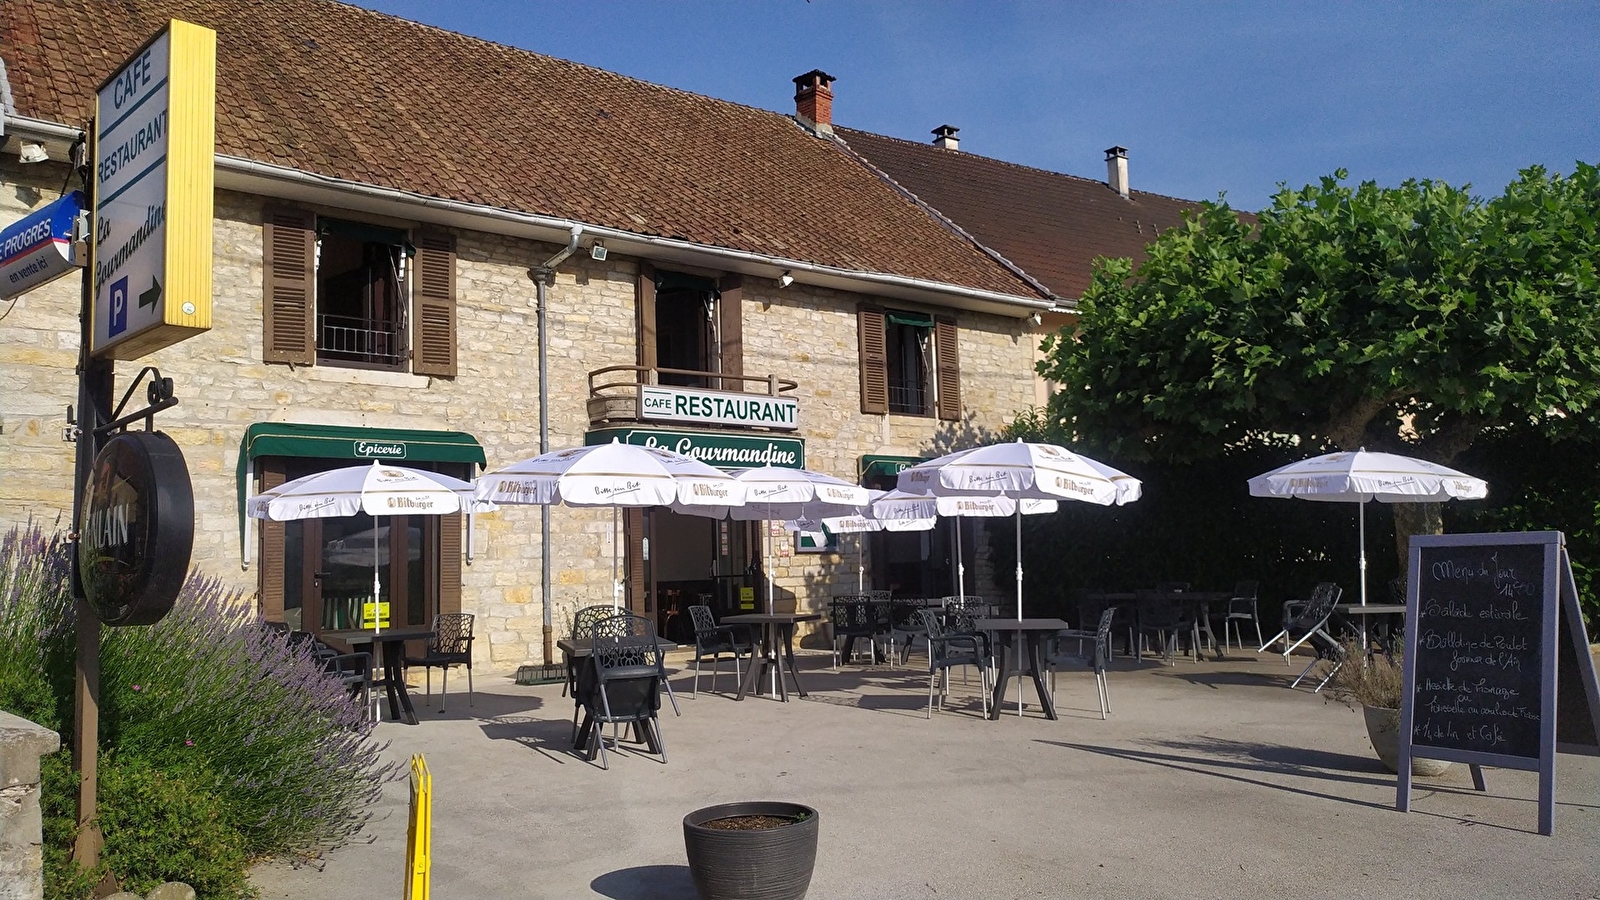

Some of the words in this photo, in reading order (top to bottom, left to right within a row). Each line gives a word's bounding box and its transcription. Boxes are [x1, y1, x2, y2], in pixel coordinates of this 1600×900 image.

[114, 50, 151, 110] CAFE
[98, 108, 167, 184] RESTAURANT
[97, 216, 111, 246] La
[9, 272, 20, 283] en
[20, 262, 39, 279] vente
[36, 255, 49, 270] ici
[113, 289, 124, 327] P
[644, 397, 672, 409] CAFE
[675, 394, 796, 423] RESTAURANT
[358, 442, 402, 457] Epicerie
[675, 437, 796, 465] Gourmandine
[1063, 478, 1094, 496] Bitburger
[397, 497, 434, 509] Bitburger
[1432, 560, 1474, 585] Menu
